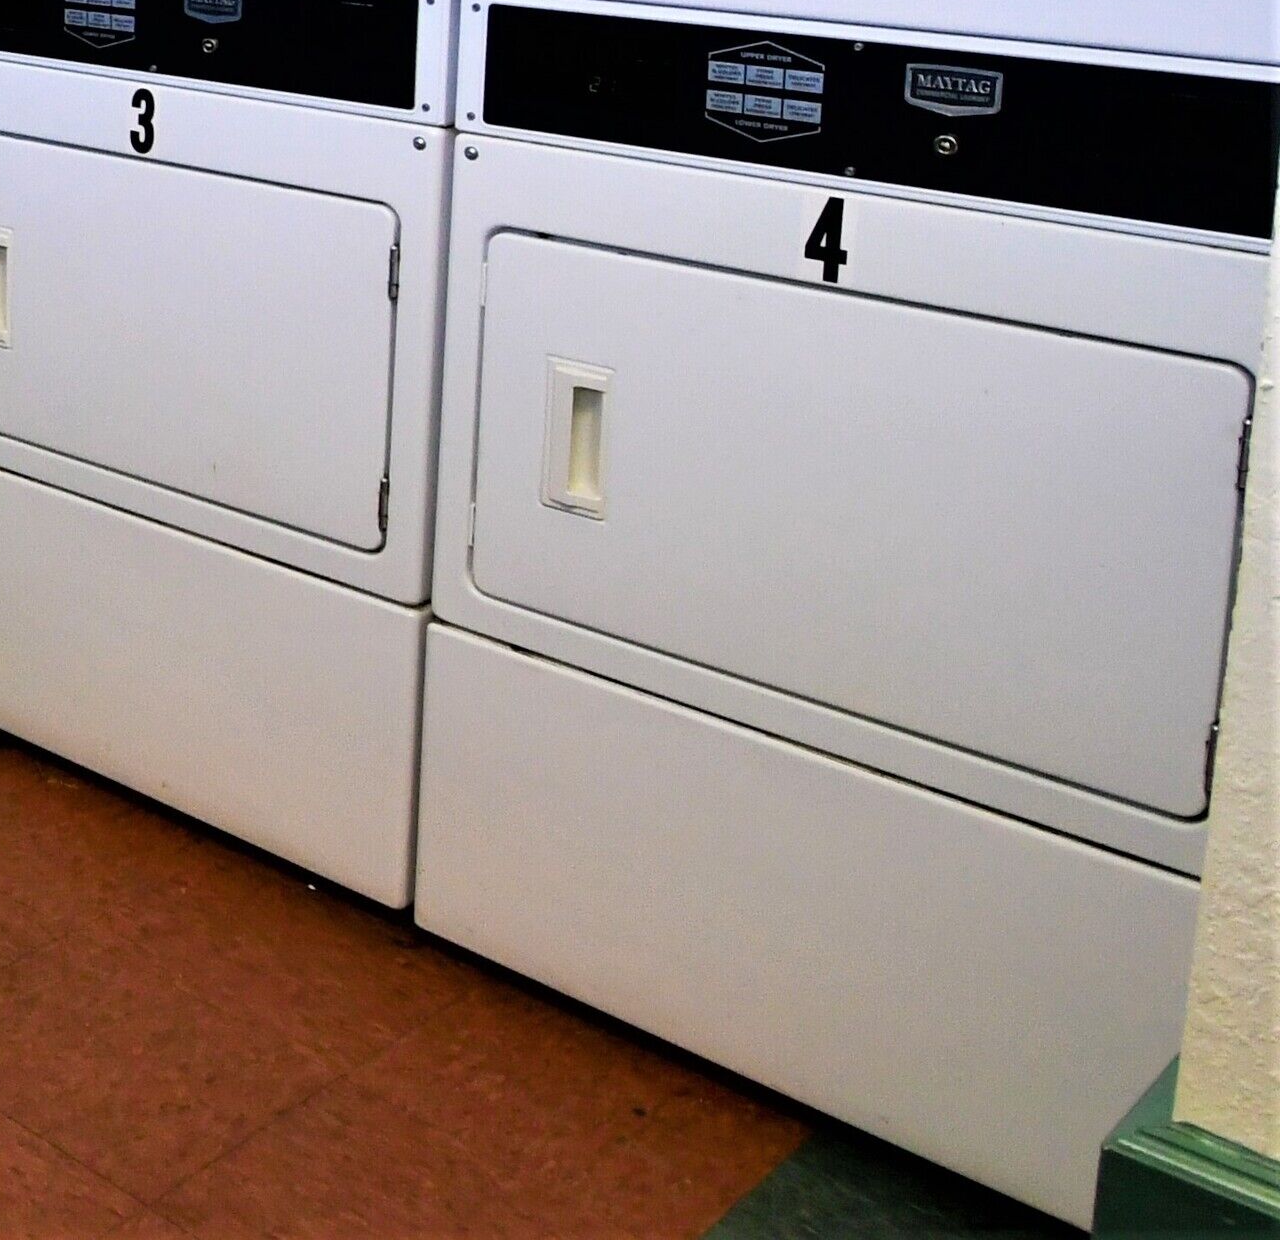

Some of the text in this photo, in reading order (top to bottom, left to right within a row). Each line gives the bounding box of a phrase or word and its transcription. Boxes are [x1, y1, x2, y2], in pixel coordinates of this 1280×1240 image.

[917, 74, 991, 94] MAYTAG
[131, 89, 155, 153] 3
[805, 197, 847, 283] 4
